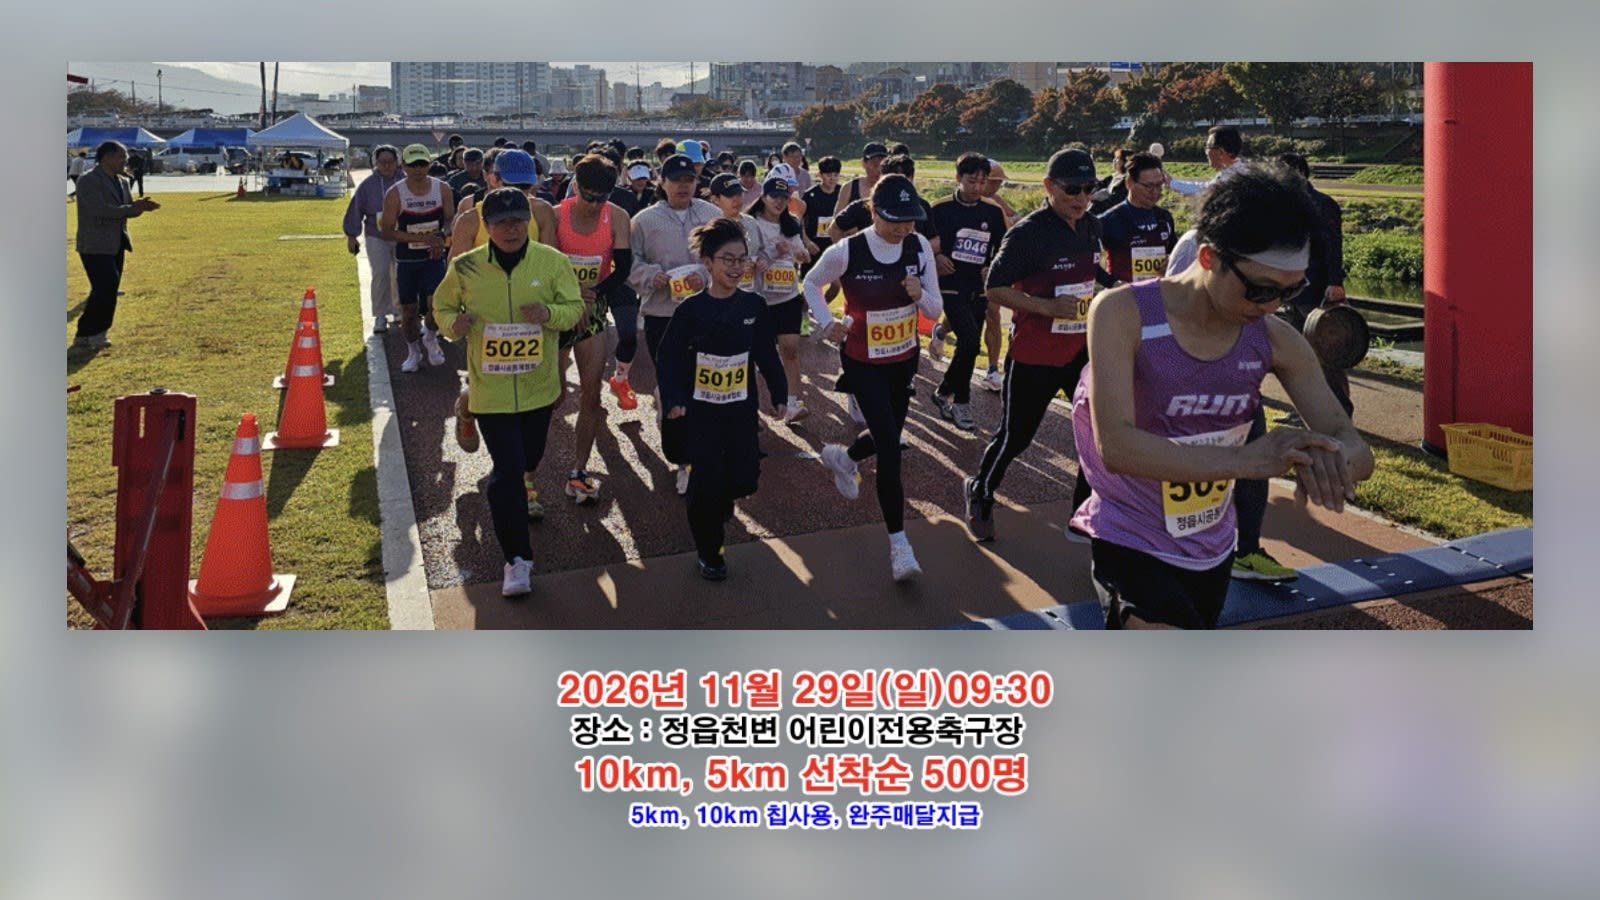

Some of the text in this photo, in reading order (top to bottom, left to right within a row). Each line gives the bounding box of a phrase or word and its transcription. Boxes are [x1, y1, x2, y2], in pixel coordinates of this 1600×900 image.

[766, 269, 795, 282] 6008
[871, 319, 913, 342] 6011
[485, 339, 540, 357] 5022
[698, 368, 745, 387] 5019
[1166, 394, 1251, 417] RUN
[1176, 507, 1223, 531] 정읍시공동
